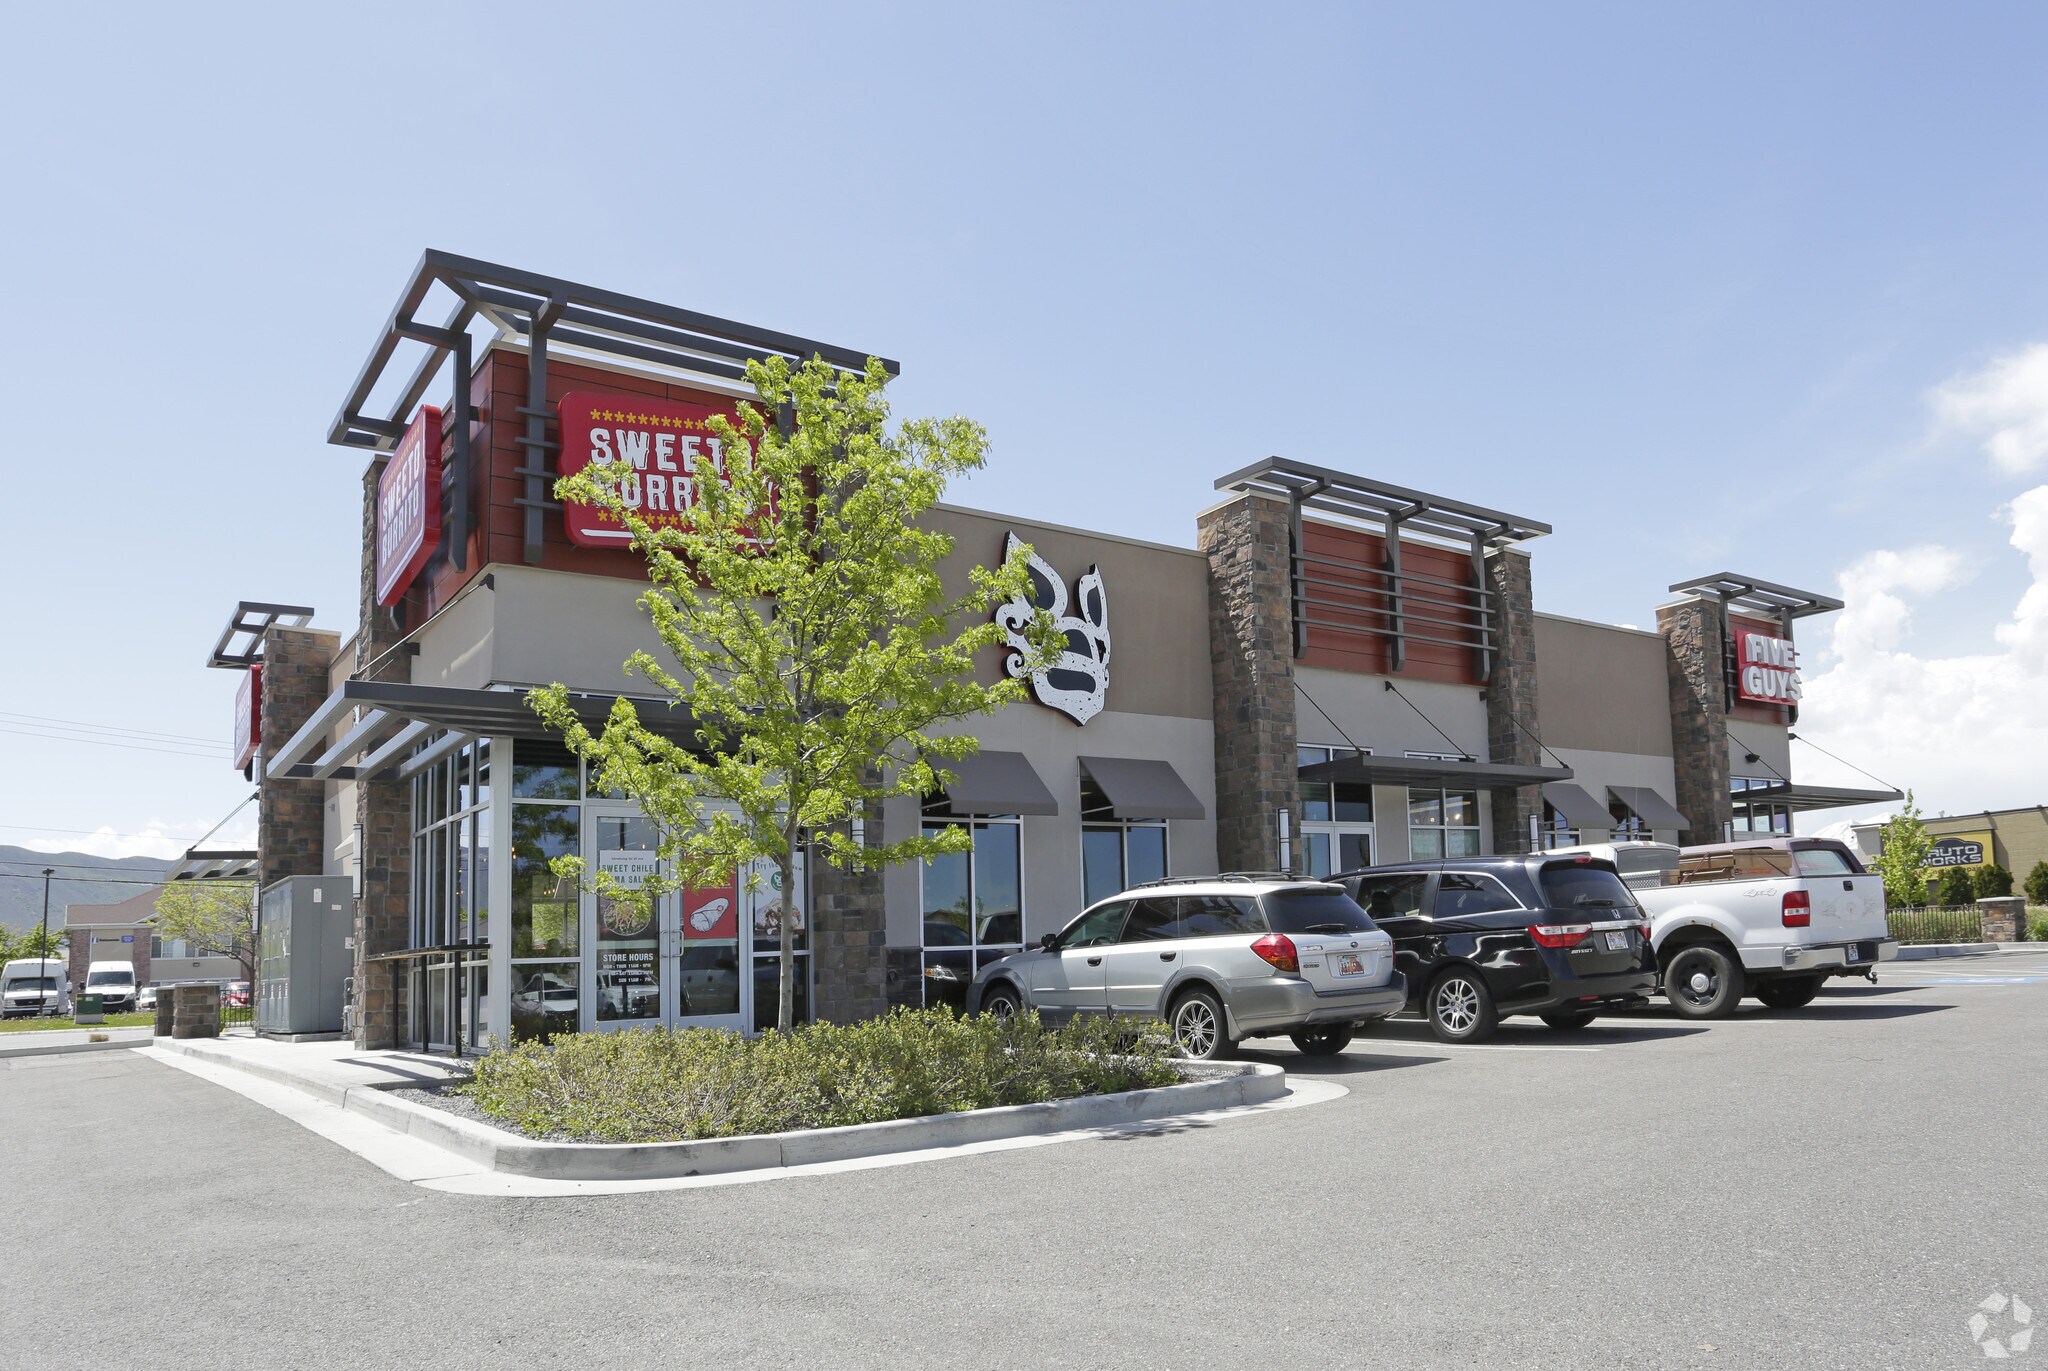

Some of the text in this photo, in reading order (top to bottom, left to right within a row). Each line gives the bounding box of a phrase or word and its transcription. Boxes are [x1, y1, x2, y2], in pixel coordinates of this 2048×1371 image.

[590, 427, 752, 476] SWEET
[382, 440, 420, 531] SWEETO
[381, 481, 419, 568] BURRITO
[1745, 633, 1795, 667] FIVE
[1742, 665, 1802, 700] GUYS
[1919, 853, 1982, 866] WORKS
[1927, 845, 1978, 857] AUTO
[602, 864, 653, 872] SWEET CHILE
[1743, 888, 1777, 897] 4x4
[603, 953, 653, 962] STORE HOURS
